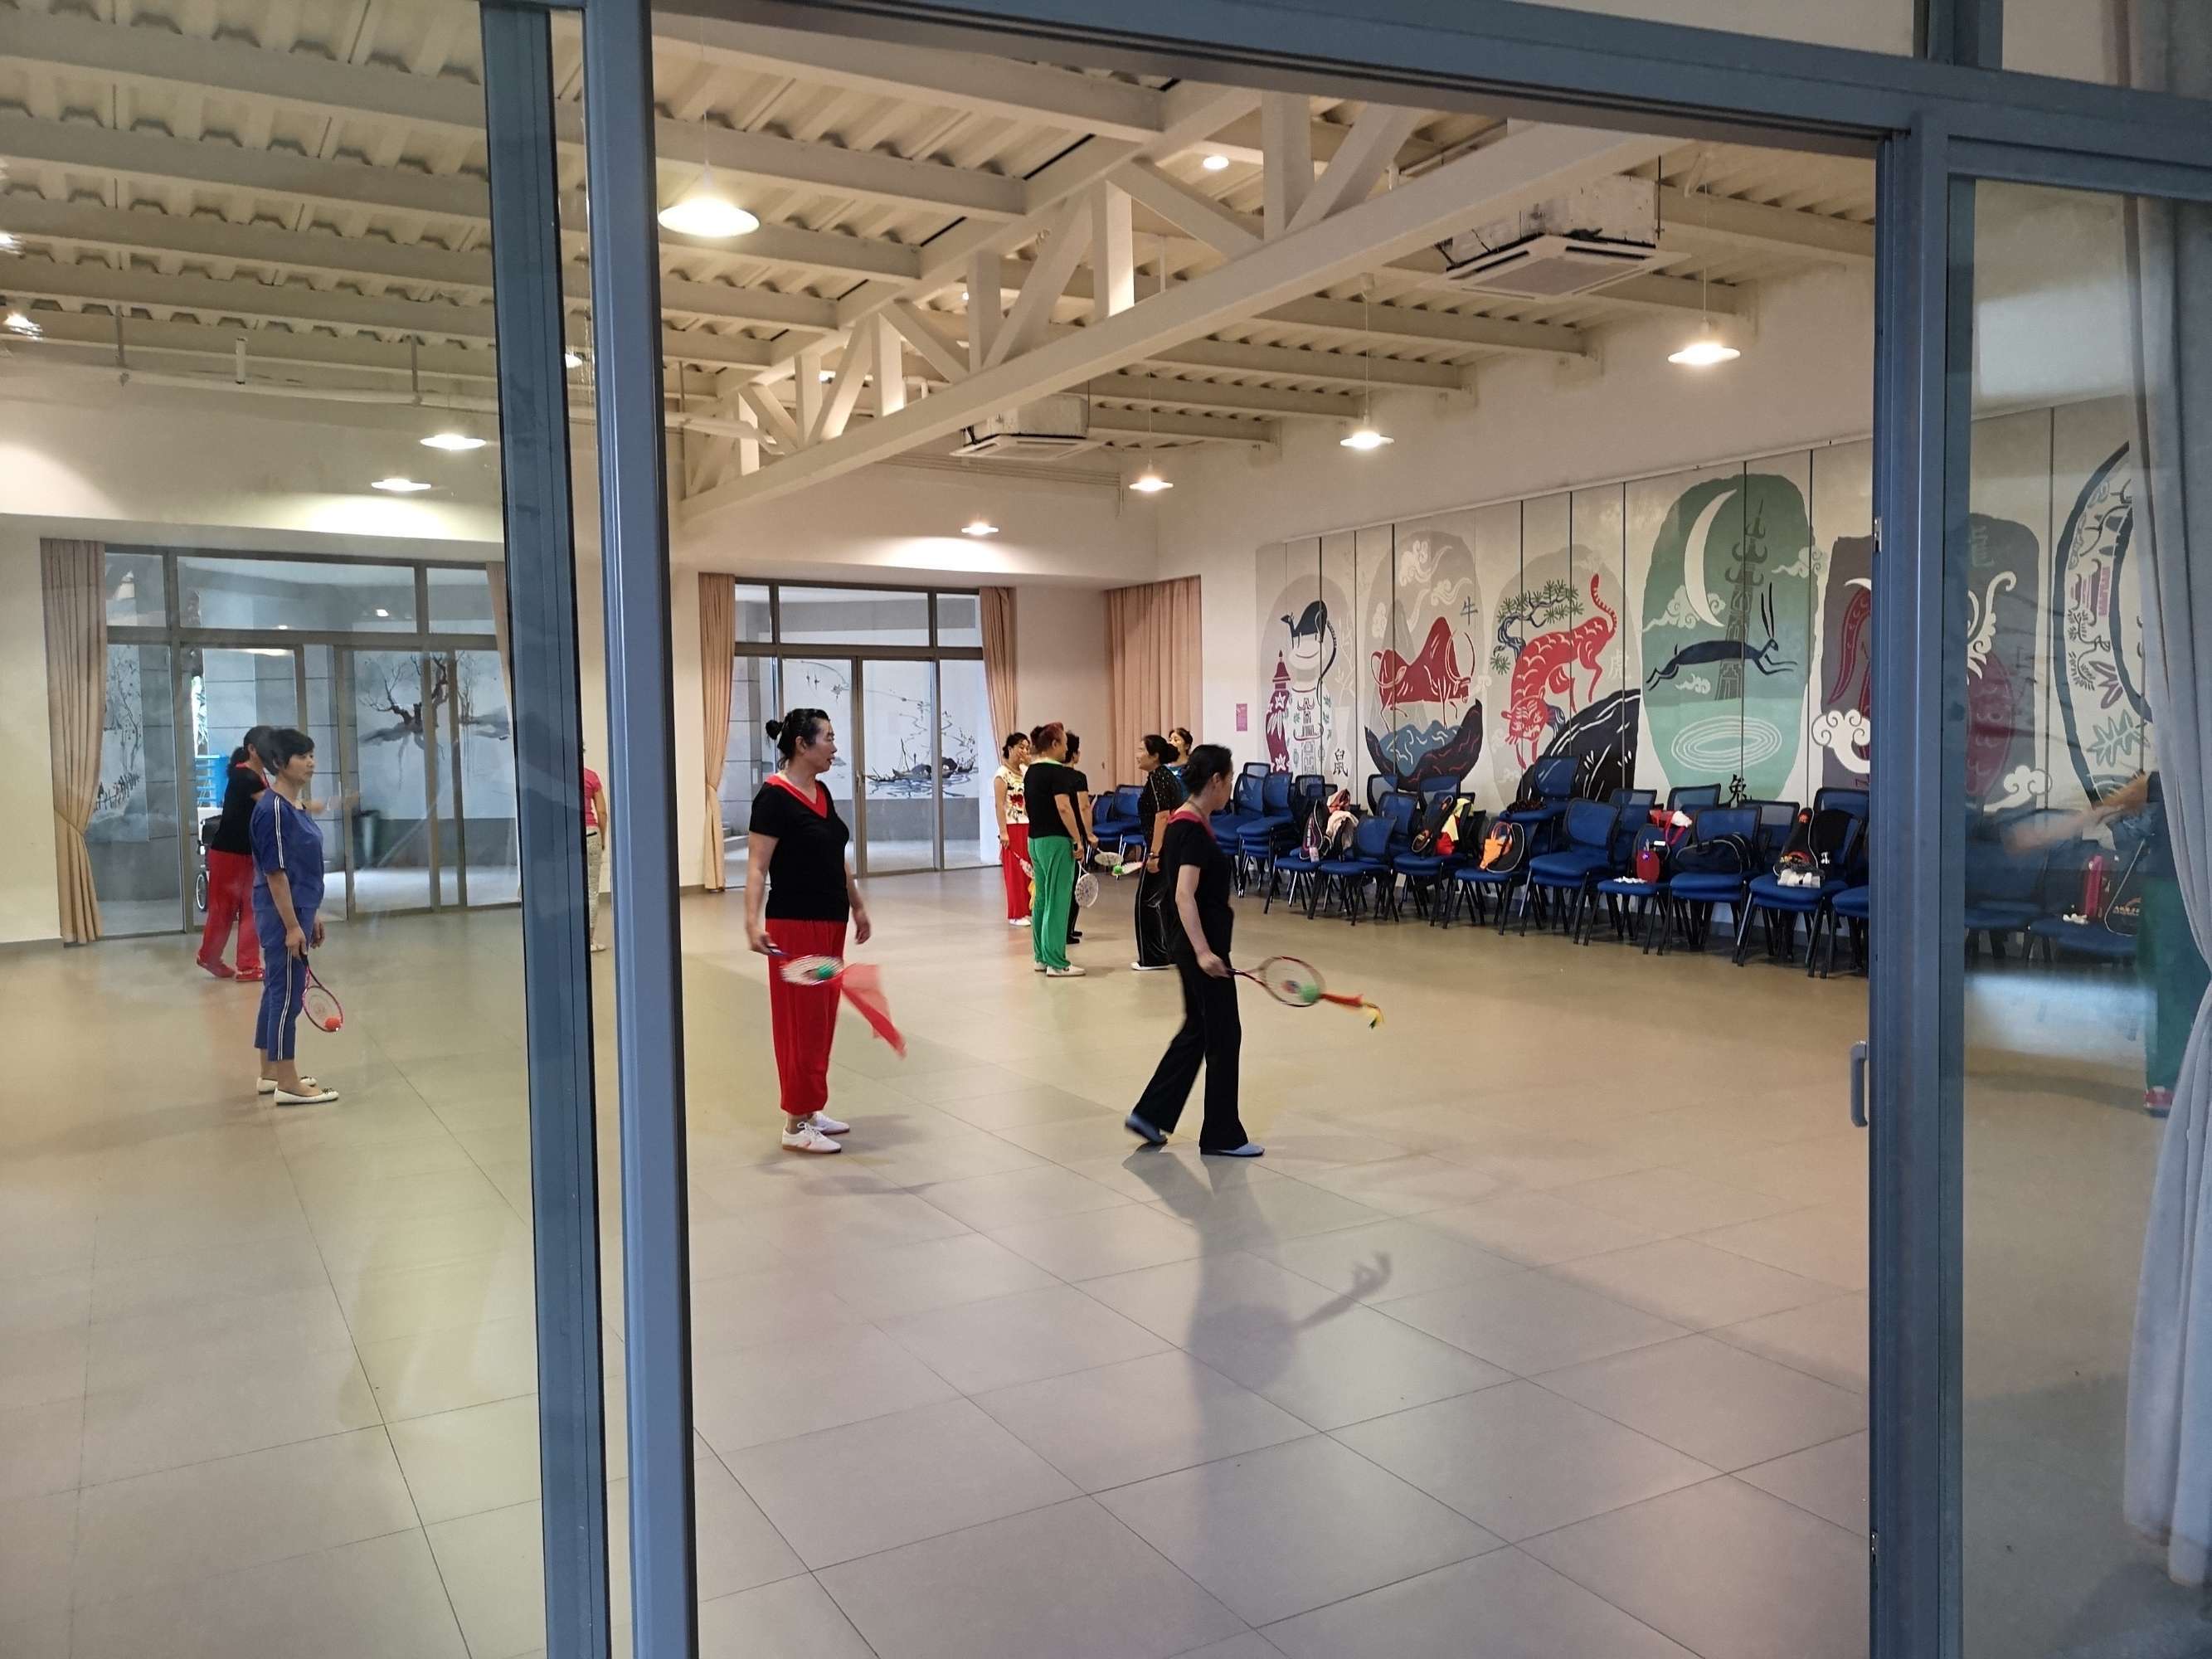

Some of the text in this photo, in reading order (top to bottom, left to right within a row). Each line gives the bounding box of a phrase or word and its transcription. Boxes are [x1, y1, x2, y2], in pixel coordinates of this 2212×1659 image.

[1460, 595, 1479, 626] 牛
[1607, 648, 1633, 681] 虎
[1332, 747, 1349, 777] 鼠
